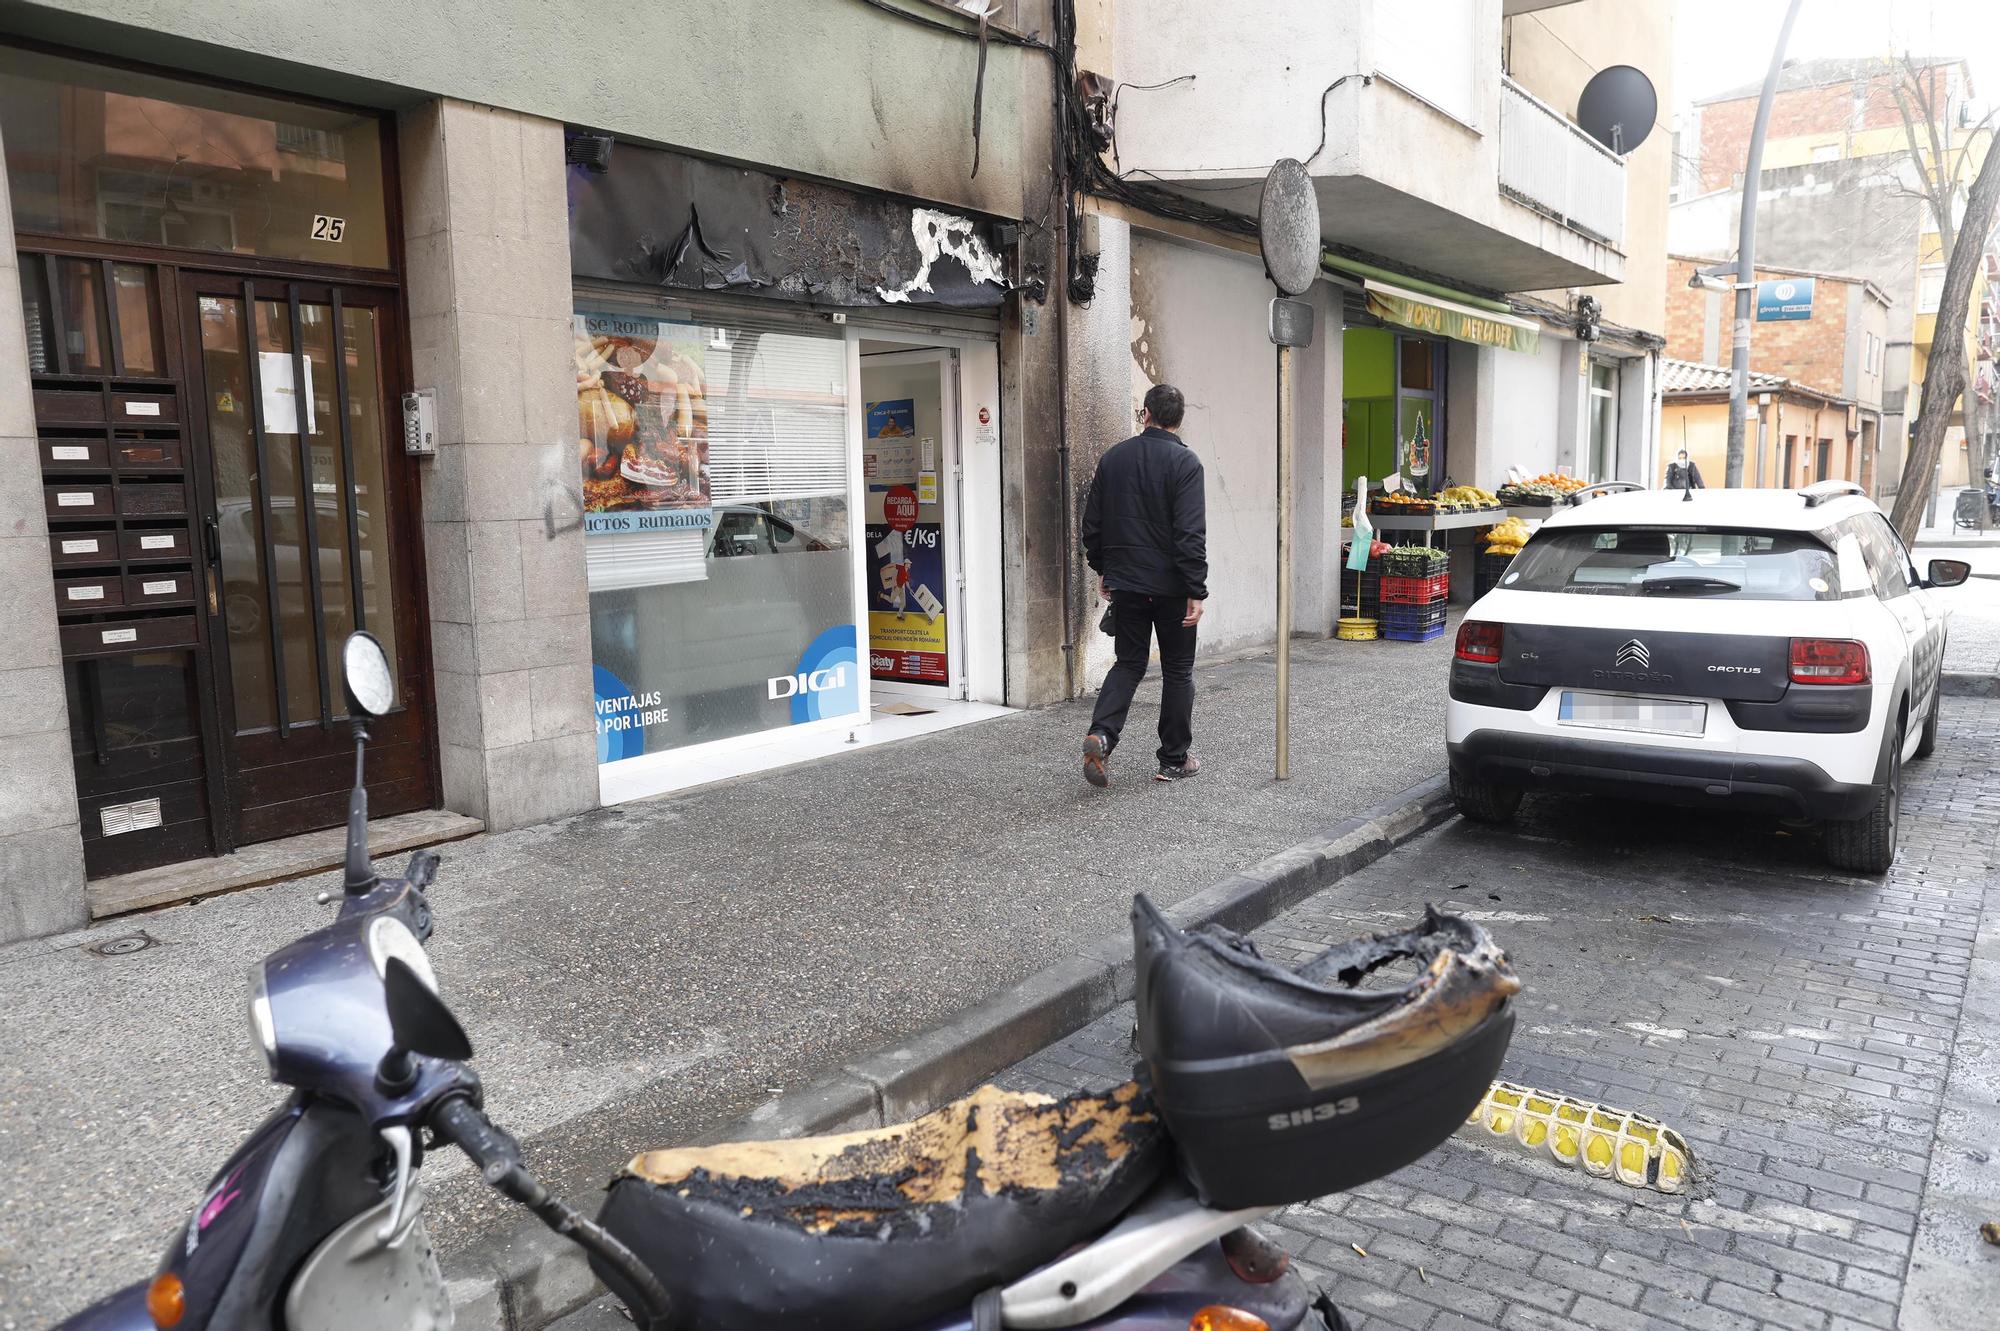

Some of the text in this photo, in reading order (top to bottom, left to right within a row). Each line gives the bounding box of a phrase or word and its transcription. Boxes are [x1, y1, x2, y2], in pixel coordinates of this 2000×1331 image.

[313, 216, 342, 241] 25
[886, 496, 912, 505] RECARGA
[1707, 665, 1761, 674] CACTUS
[767, 666, 846, 700] DIGI
[595, 691, 662, 715] VENTAJAS
[604, 715, 631, 733] POR
[634, 708, 669, 728] LIBRE
[1267, 1096, 1360, 1131] SH33
